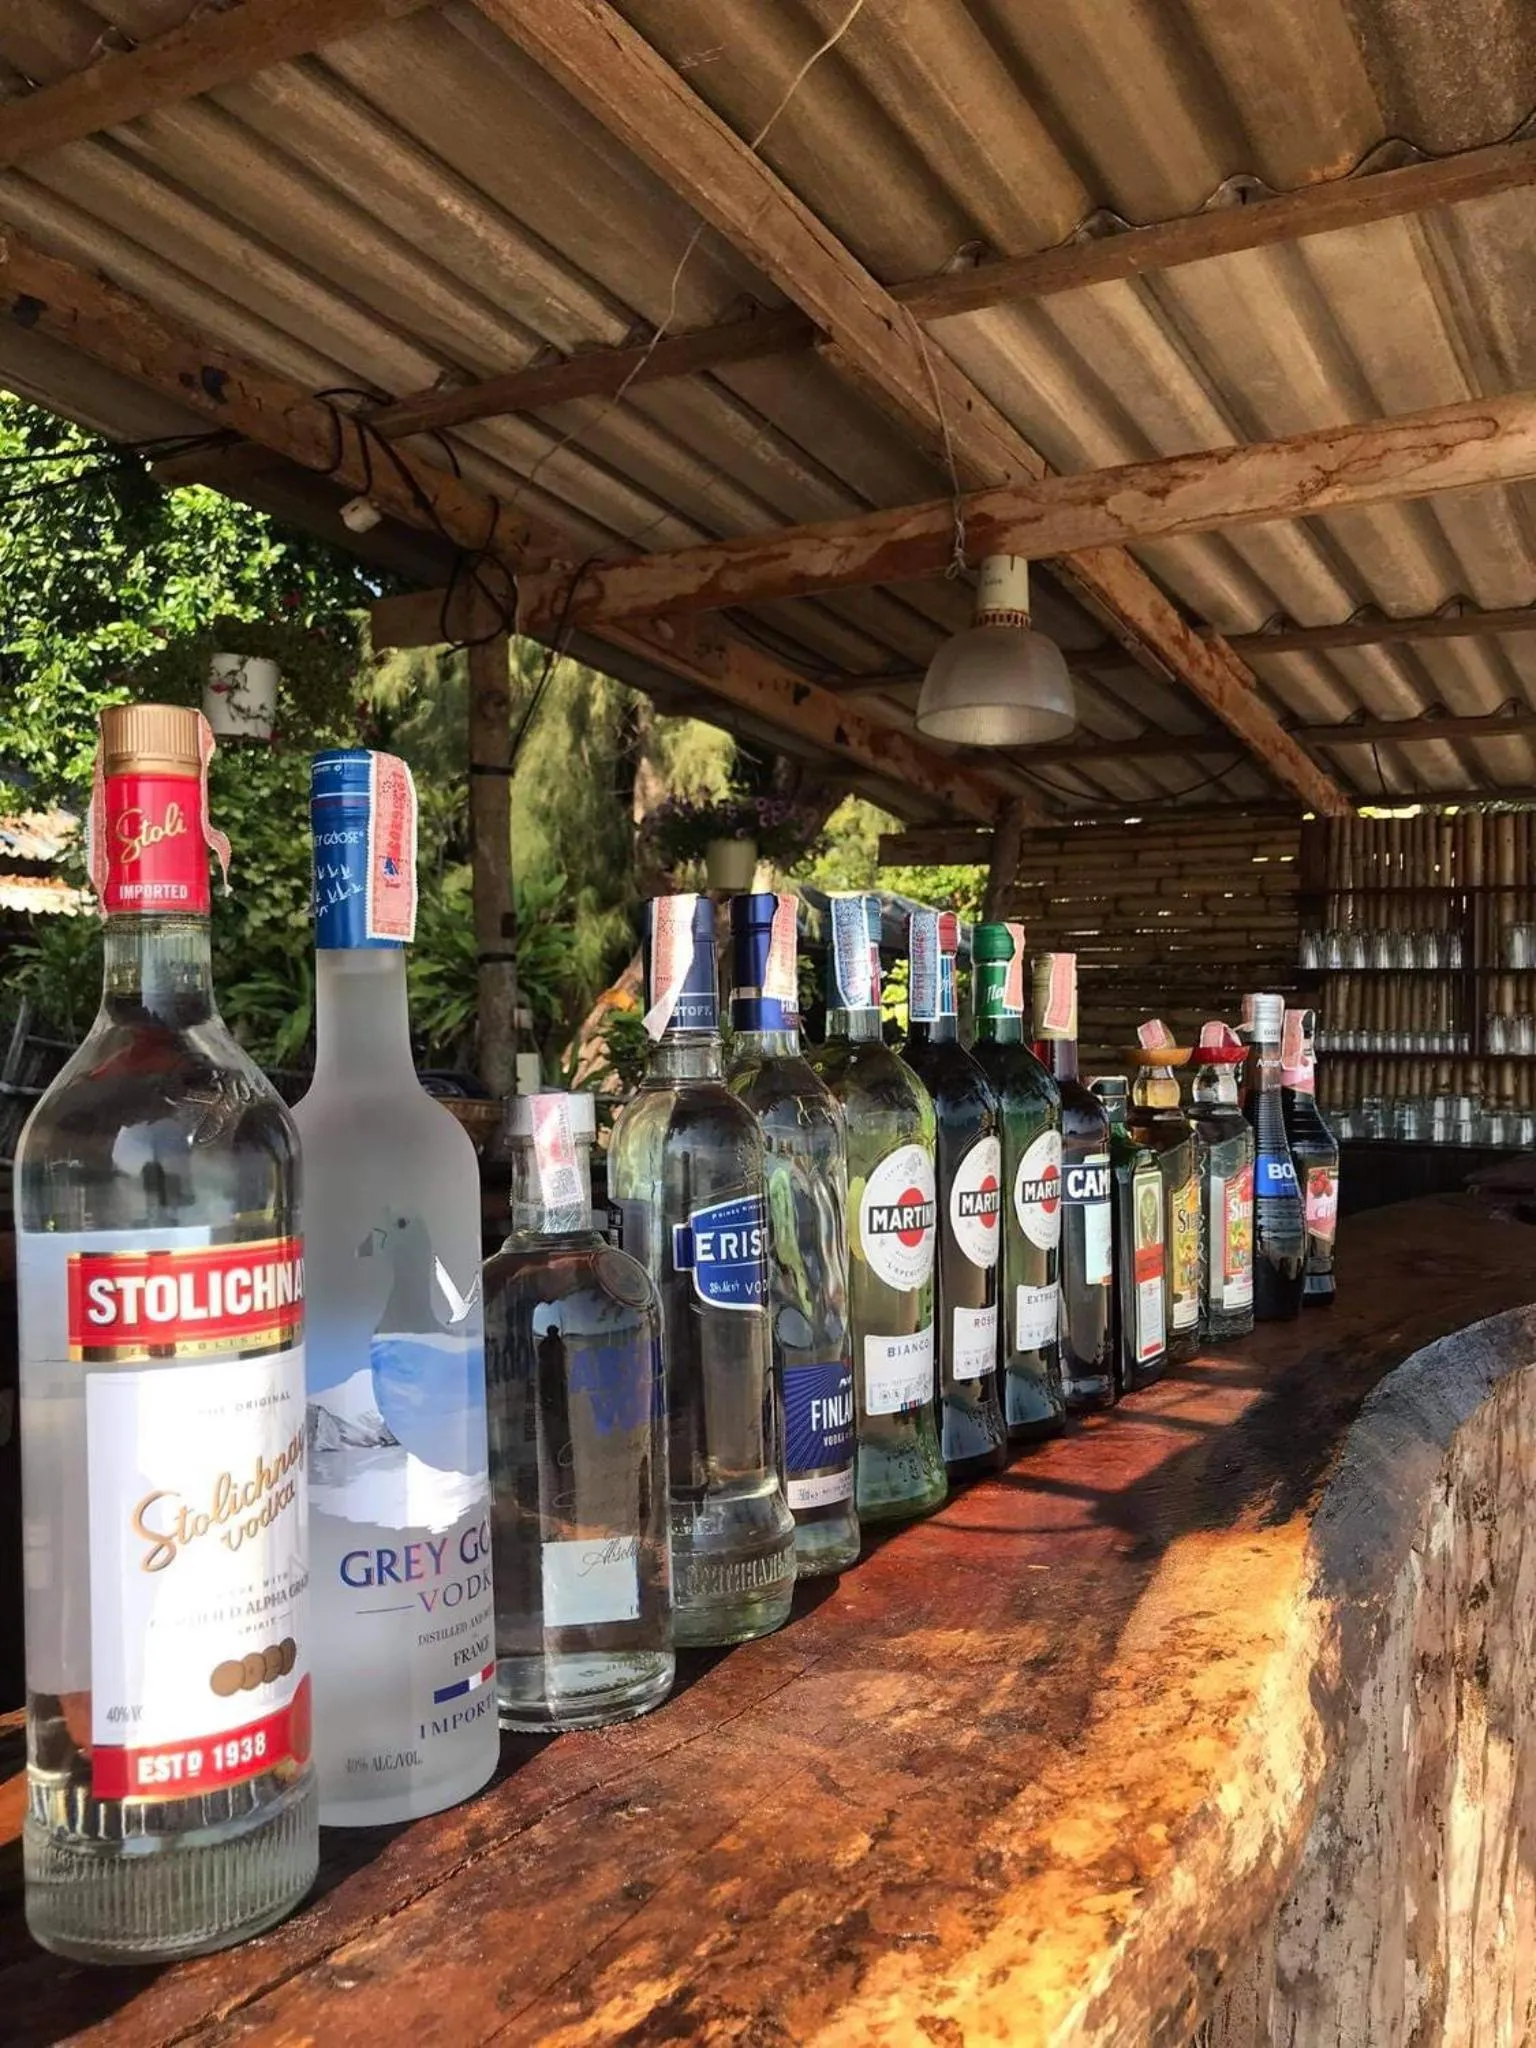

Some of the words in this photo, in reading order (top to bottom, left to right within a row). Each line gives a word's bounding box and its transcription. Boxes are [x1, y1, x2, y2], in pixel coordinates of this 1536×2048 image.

[116, 803, 187, 864] Stoli
[119, 885, 188, 900] IMPORTED
[87, 1257, 305, 1325] STOLICHNA
[887, 1338, 929, 1358] BIANCO
[235, 1391, 291, 1413] ORIGINAL
[220, 1480, 296, 1552] vodka
[340, 1537, 448, 1588] GREY
[106, 1706, 130, 1724] 40%
[213, 1732, 267, 1771] 1938
